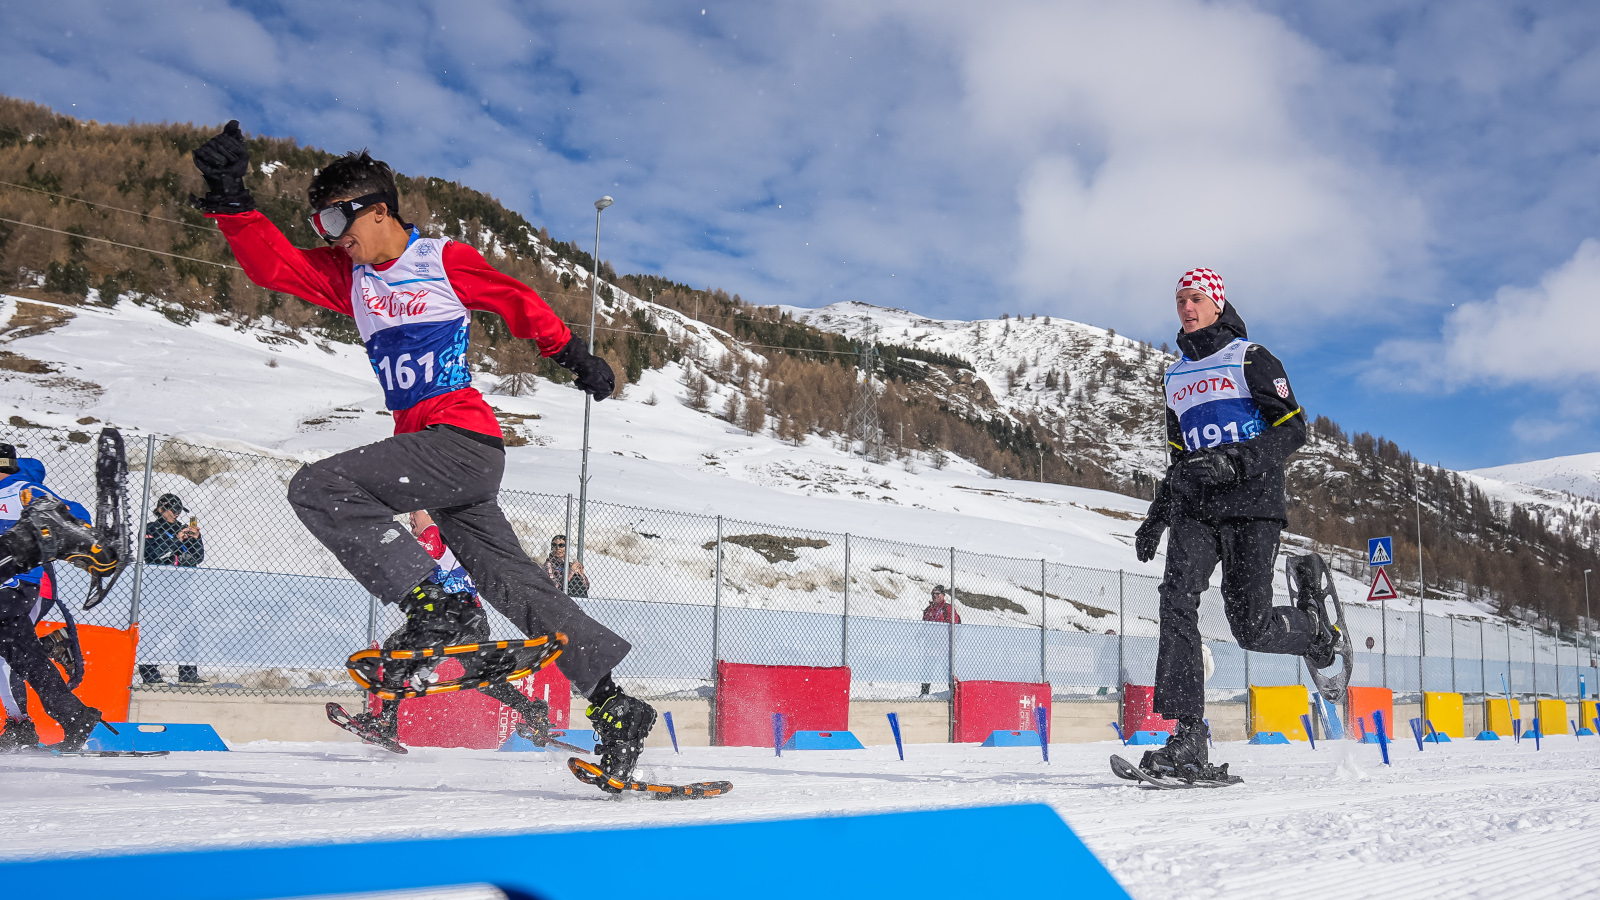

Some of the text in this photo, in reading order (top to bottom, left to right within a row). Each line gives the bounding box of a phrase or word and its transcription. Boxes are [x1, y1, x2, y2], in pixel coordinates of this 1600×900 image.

[378, 351, 435, 391] 161
[1172, 377, 1235, 405] TOYOTA
[1187, 421, 1240, 450] 191
